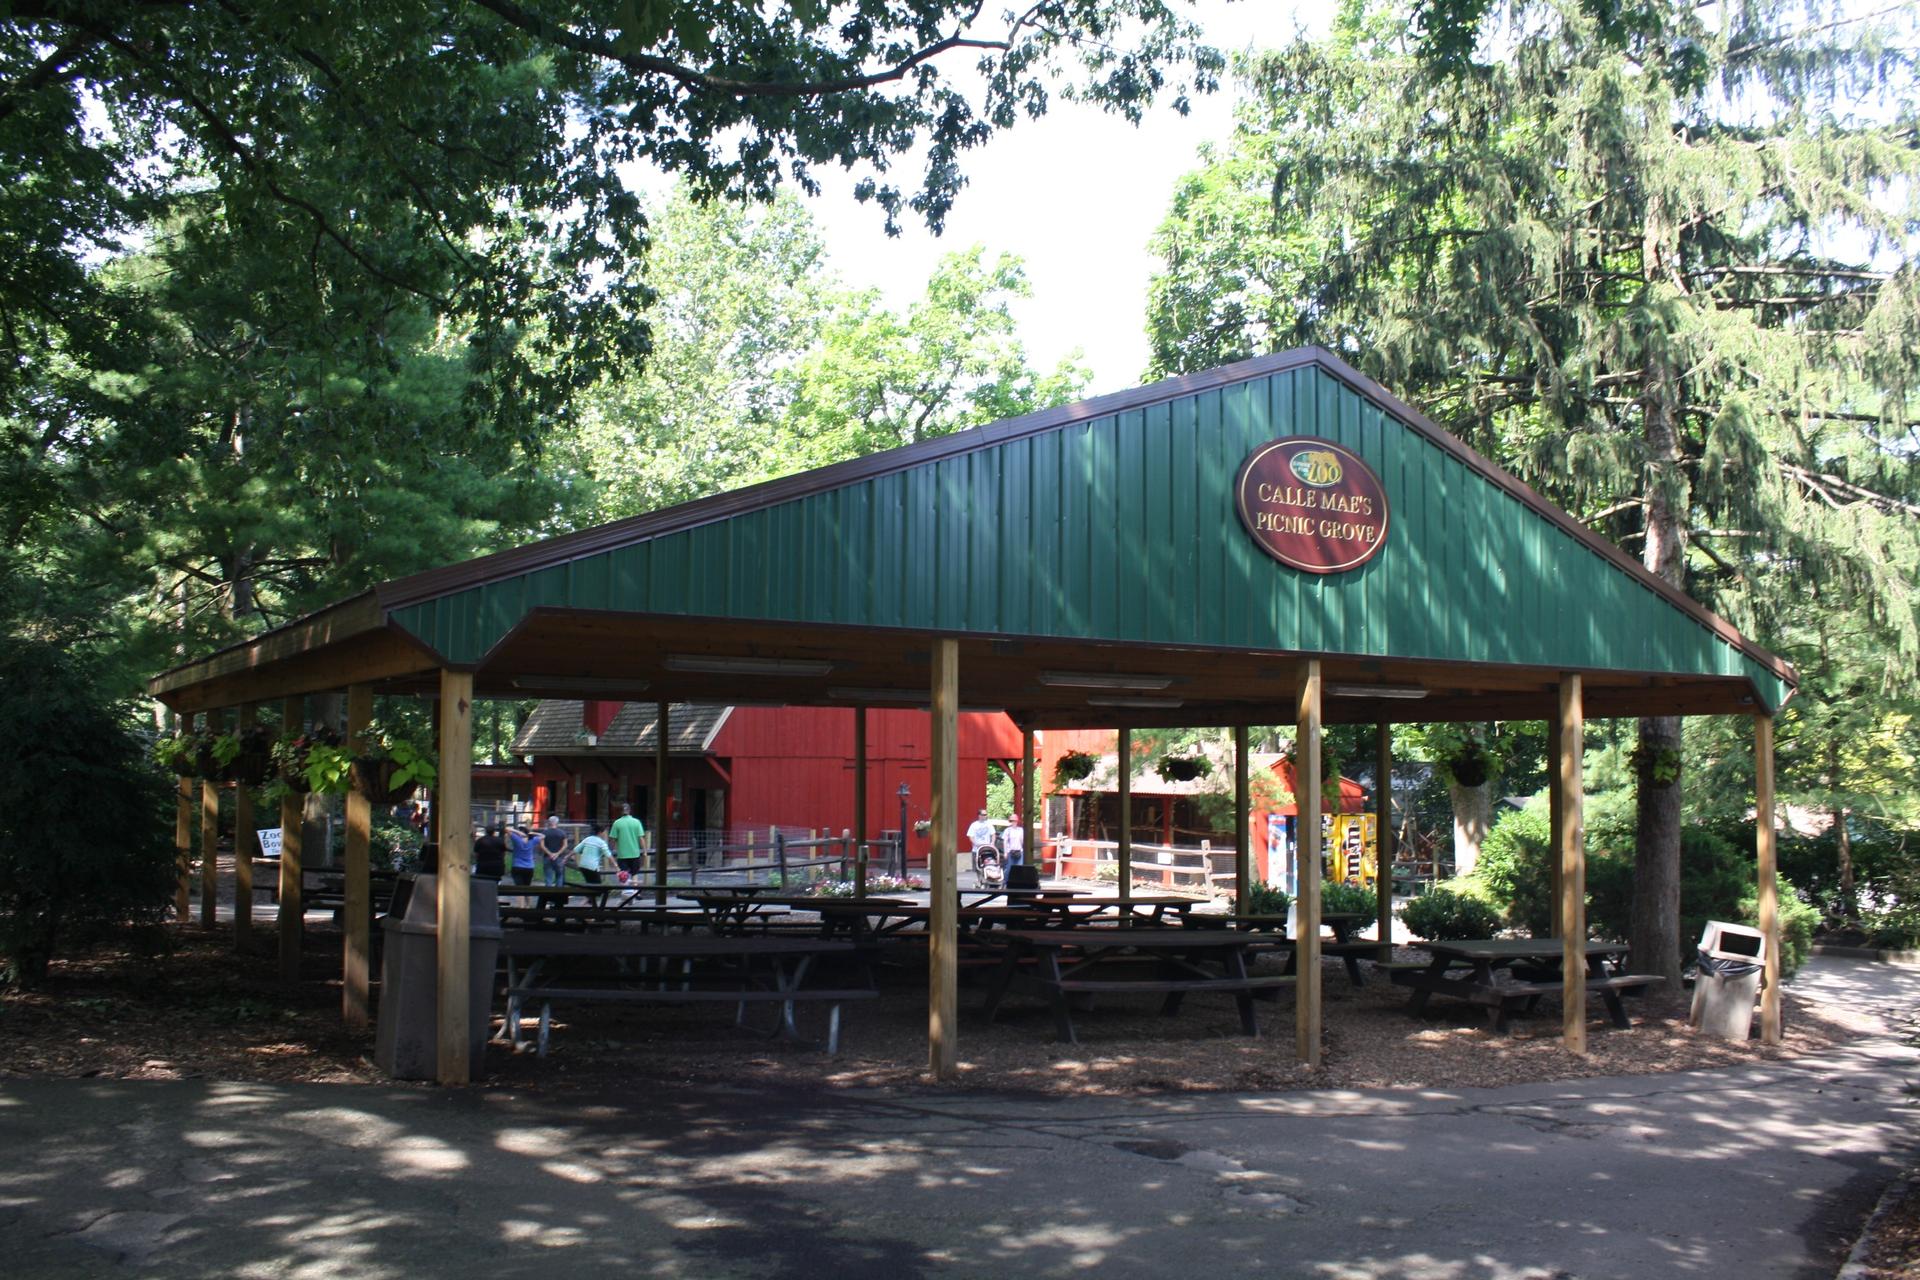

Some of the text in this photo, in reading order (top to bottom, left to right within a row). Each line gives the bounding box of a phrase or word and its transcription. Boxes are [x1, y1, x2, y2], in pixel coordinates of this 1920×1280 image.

[1258, 482, 1373, 516] CALLE MAE'S
[1256, 511, 1375, 543] PICNIC GROVE
